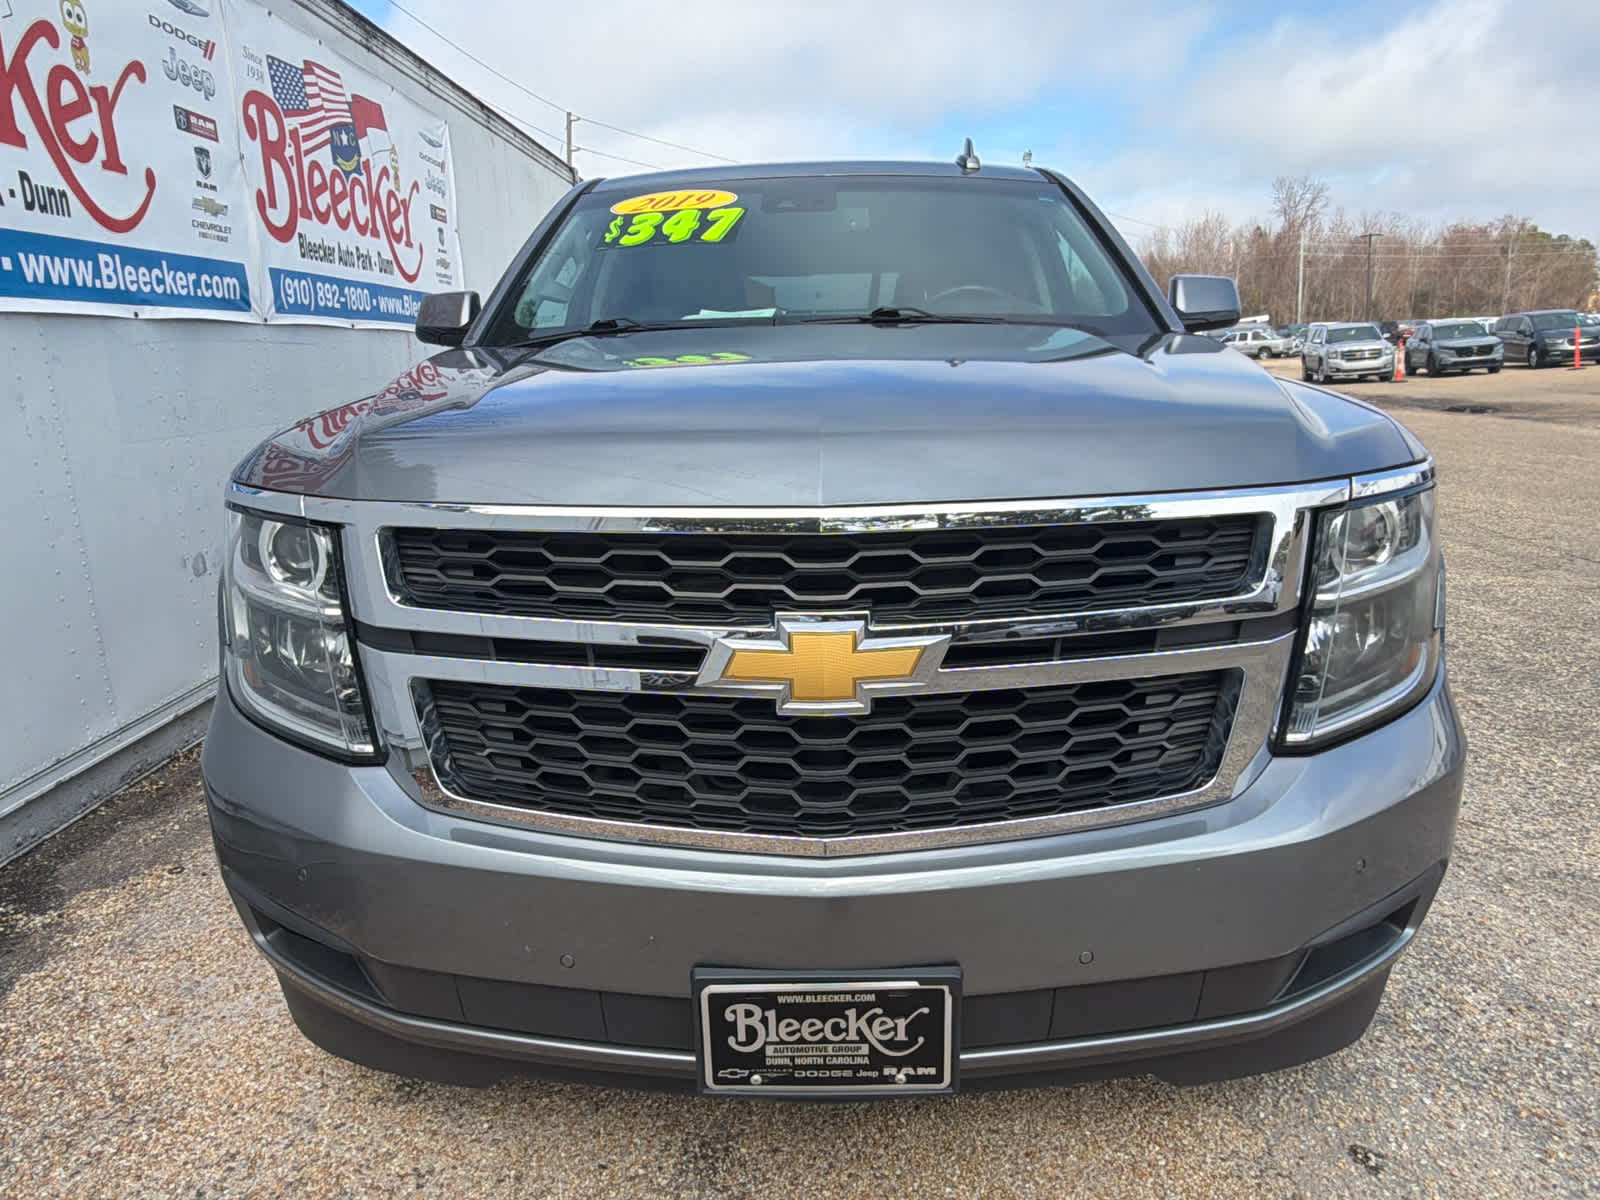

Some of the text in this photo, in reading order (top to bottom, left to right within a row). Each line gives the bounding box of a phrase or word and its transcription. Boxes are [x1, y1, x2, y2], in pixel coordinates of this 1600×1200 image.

[149, 14, 208, 52] DODGE
[162, 46, 216, 101] Jeep
[190, 115, 215, 131] RAM
[18, 170, 71, 218] Dunn
[196, 180, 217, 192] RAM
[243, 90, 423, 283] Bleecker
[631, 191, 717, 213] 2019
[192, 219, 232, 234] CHEVROLET
[604, 207, 745, 247] $347
[298, 231, 335, 265] Bleecker
[338, 241, 355, 269] Auto
[355, 245, 374, 272] Park
[377, 250, 394, 275] Dunn
[18, 252, 241, 300] www.Bleecker.com
[280, 273, 315, 311] (910)
[316, 281, 371, 312] 892-1800
[777, 993, 876, 1004] WWW.BLEECKER.COM
[724, 1003, 930, 1057] Bleecker
[765, 1056, 870, 1067] DUNN, NORTH CAROLINA
[773, 1045, 863, 1055] AUTOMOTIVE GROUP
[794, 1069, 853, 1078] DODGE
[856, 1068, 879, 1078] Jeep
[883, 1067, 936, 1076] RAM
